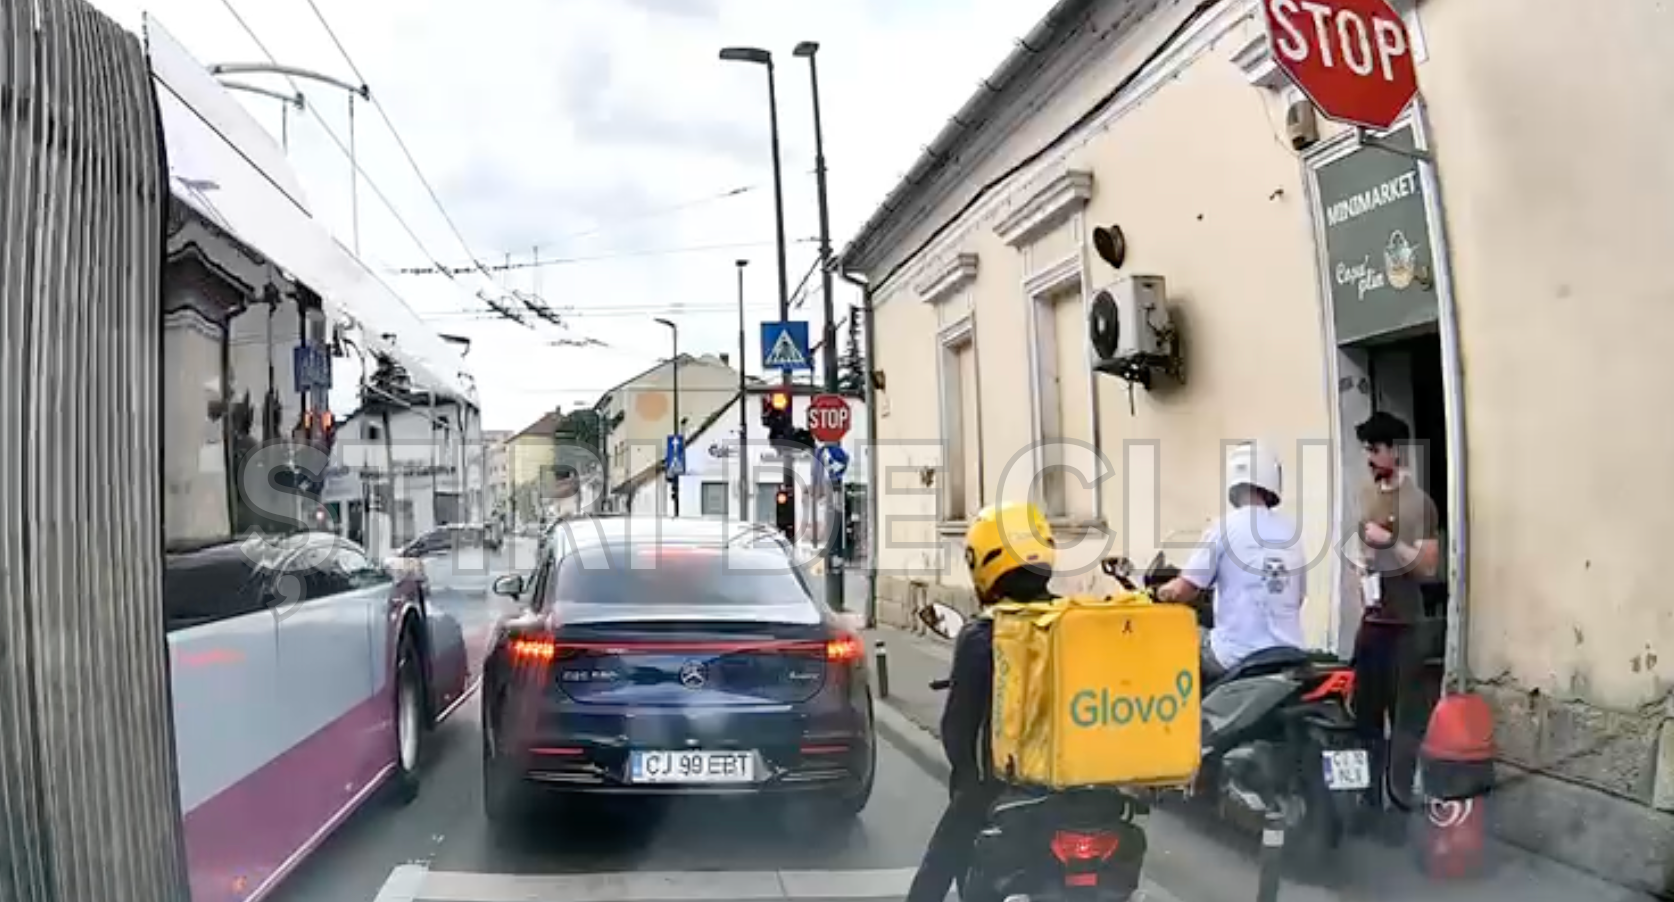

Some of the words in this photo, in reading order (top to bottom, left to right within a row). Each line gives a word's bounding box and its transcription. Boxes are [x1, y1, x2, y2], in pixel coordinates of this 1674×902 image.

[1270, 0, 1406, 81] STOP
[1326, 170, 1417, 227] MINIMARKET
[809, 408, 849, 430] STOP
[1070, 688, 1177, 727] Glovo
[646, 755, 672, 776] CJ
[680, 755, 703, 776] 99
